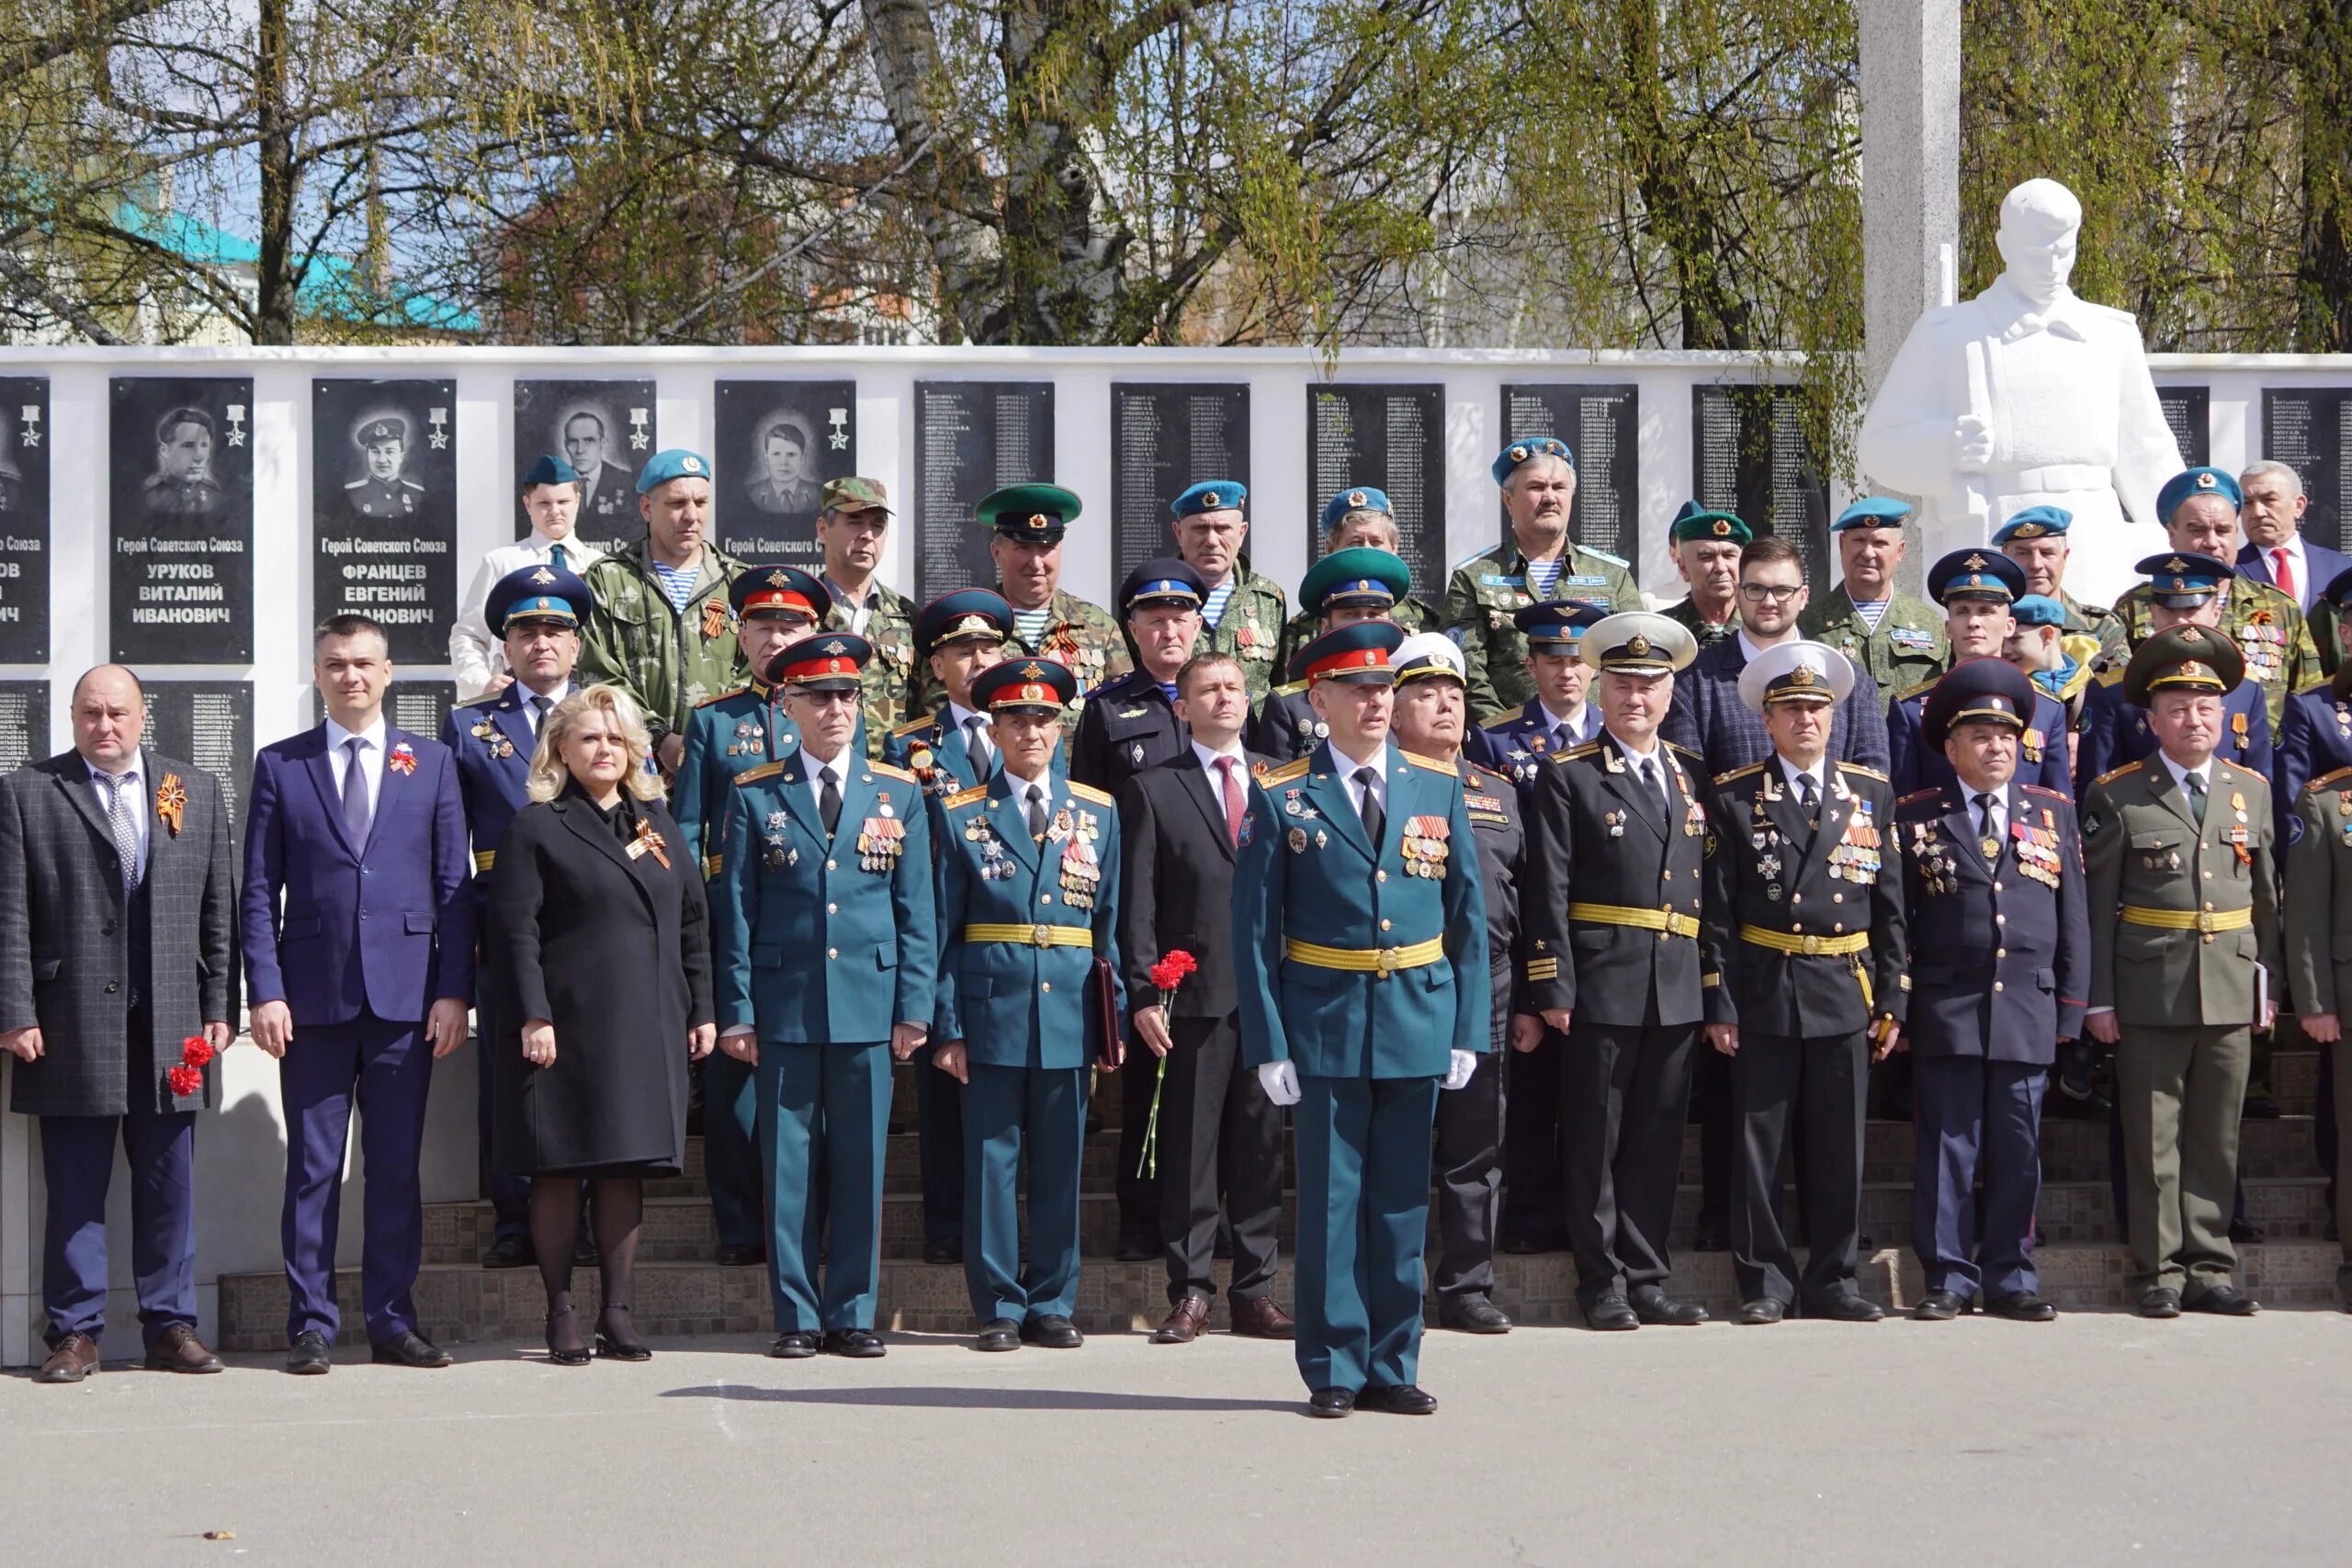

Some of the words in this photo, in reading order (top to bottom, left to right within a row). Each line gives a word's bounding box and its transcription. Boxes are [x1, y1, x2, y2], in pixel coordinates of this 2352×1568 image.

[6, 536, 40, 551] Союза
[118, 537, 147, 556] Герой
[151, 536, 207, 553] Советского
[209, 536, 243, 553] Союза
[322, 537, 352, 557] Герой
[355, 537, 412, 553] Советского
[413, 537, 447, 553] Союза
[726, 537, 755, 556] Герой
[757, 537, 812, 553] Советского
[147, 564, 214, 579] УРУКОВ
[342, 564, 426, 581] ФРАНЦЕВ
[140, 583, 222, 601] ВИТАЛИЙ
[345, 583, 424, 602] ЕВГЕНИЙ
[132, 608, 231, 623] ИВАНОВИЧ
